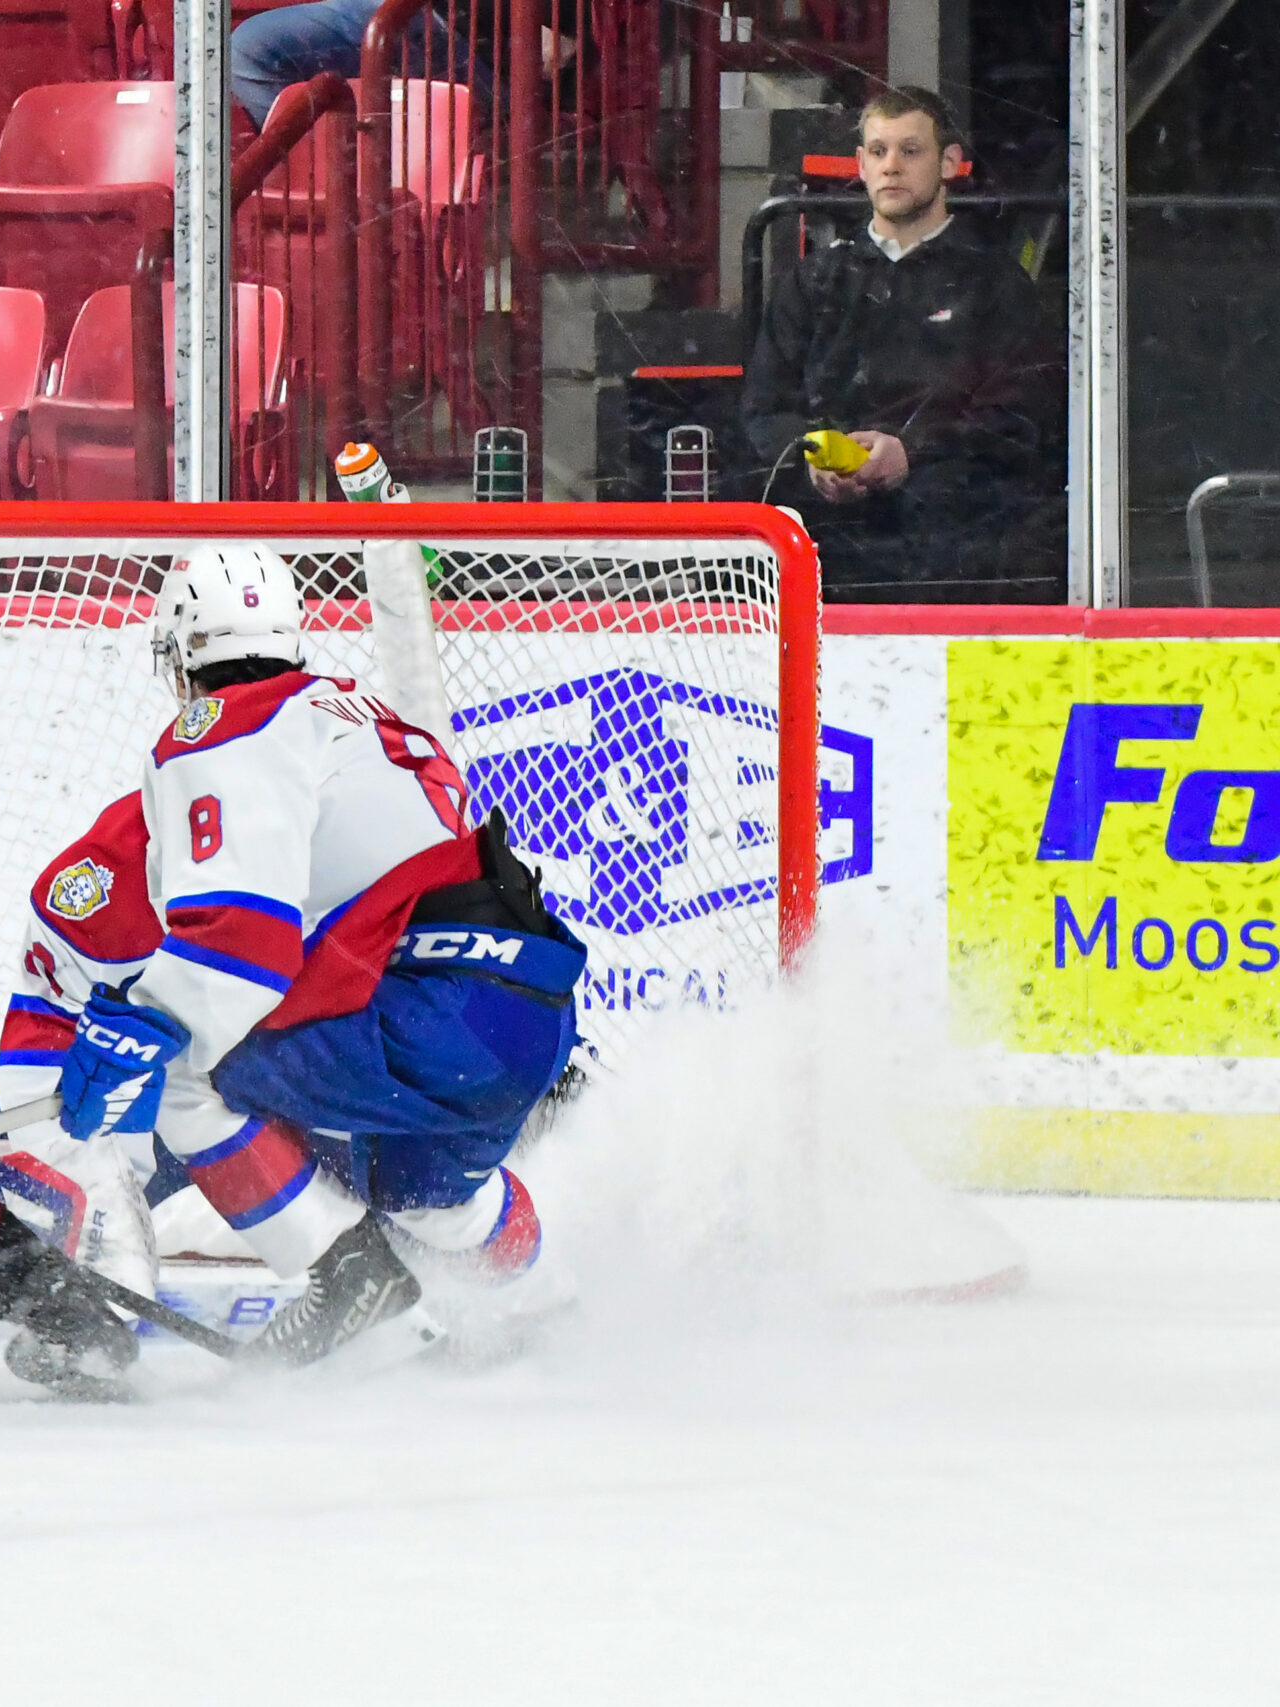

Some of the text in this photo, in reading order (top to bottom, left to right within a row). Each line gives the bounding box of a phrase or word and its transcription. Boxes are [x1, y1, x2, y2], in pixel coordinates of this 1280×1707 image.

[1035, 703, 1280, 863] Fo
[188, 794, 223, 864] 8
[1054, 896, 1280, 973] Moos
